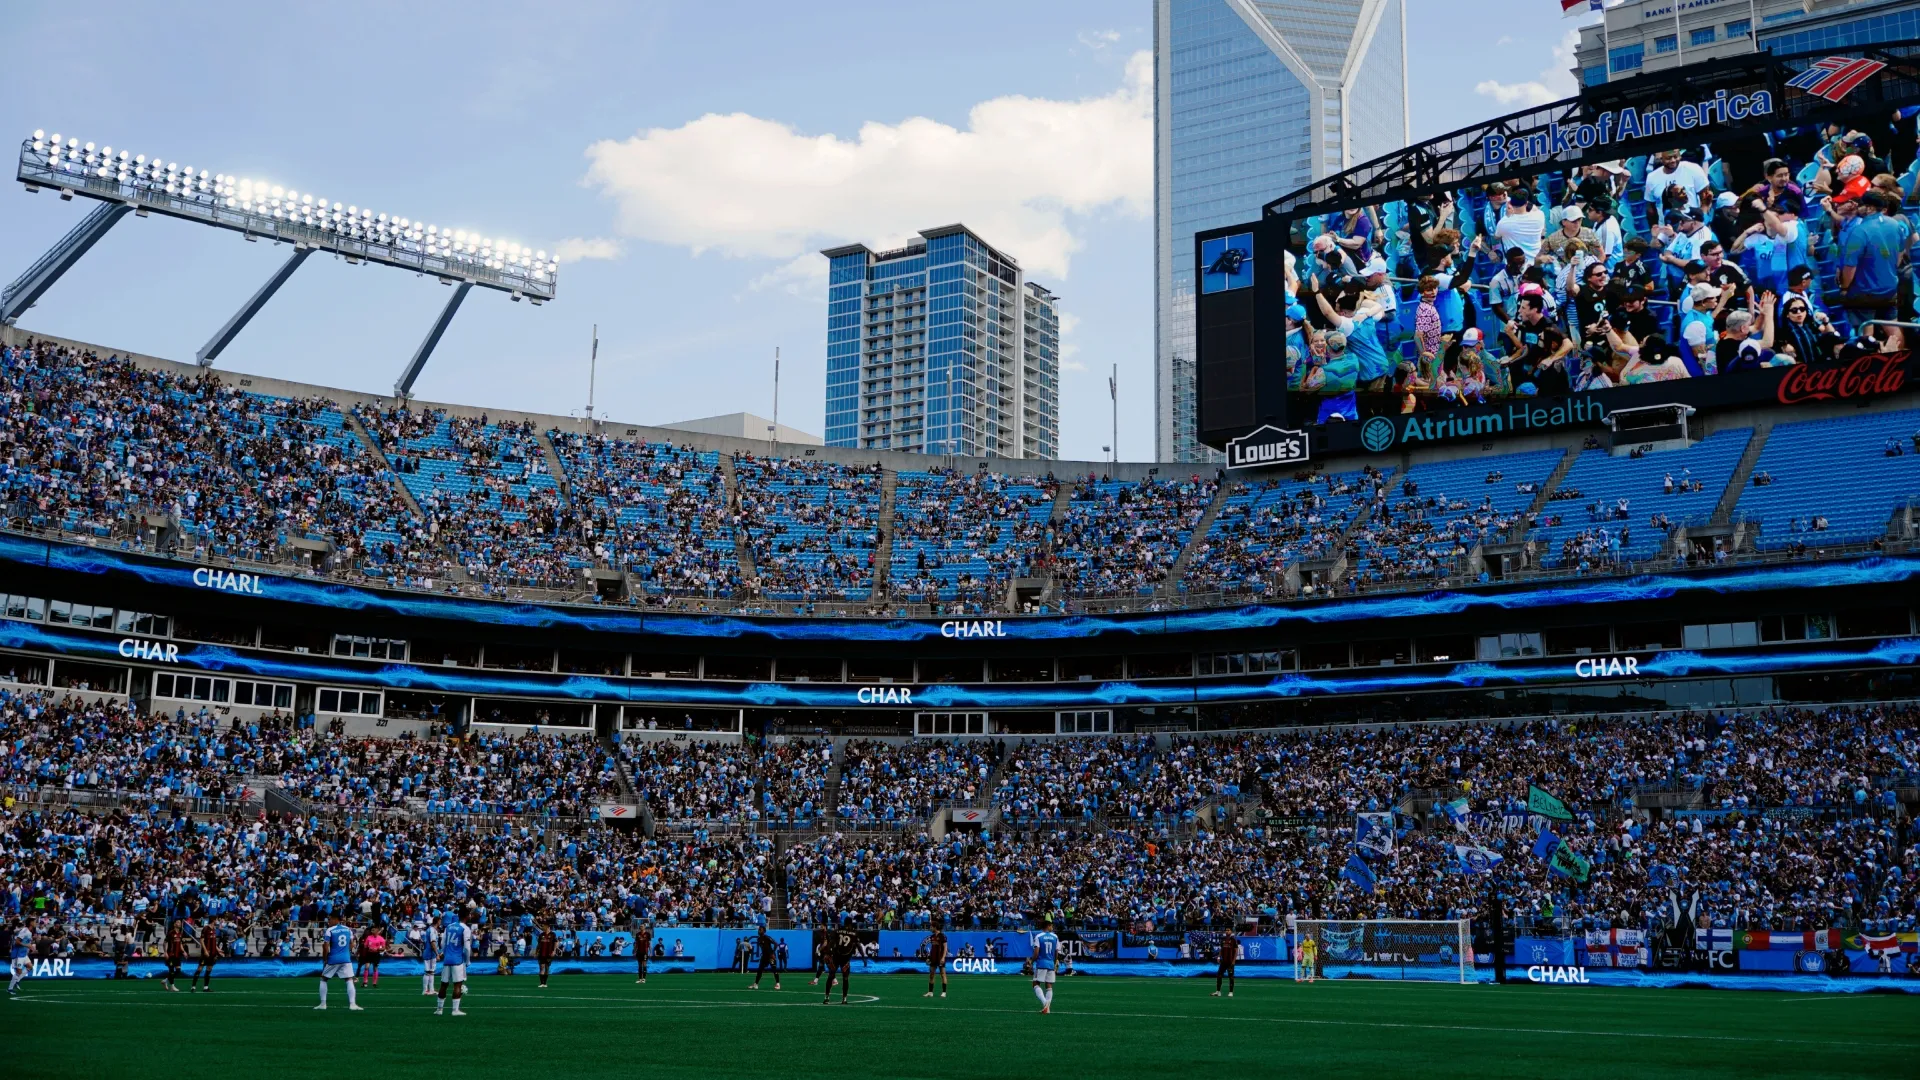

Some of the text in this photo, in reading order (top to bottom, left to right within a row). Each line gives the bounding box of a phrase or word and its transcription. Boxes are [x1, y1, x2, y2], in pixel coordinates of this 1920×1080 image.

[1645, 7, 1672, 18] BANK
[1483, 89, 1773, 166] Bank of America
[1401, 395, 1604, 442] Atrium Health
[1235, 438, 1300, 464] LOWE'S
[192, 568, 263, 595] CHARL
[941, 620, 1006, 637] CHARL
[118, 637, 178, 663] CHAR
[1575, 657, 1640, 678] CHAR
[857, 687, 912, 704] CHAR
[375, 718, 388, 727] 321
[338, 934, 347, 947] 8
[446, 931, 459, 947] 14
[838, 934, 851, 947] 19
[1044, 941, 1053, 954] 11
[1411, 935, 1440, 944] ROYAL
[1443, 934, 1476, 944] FAMY
[953, 957, 998, 972] CHARL
[1708, 950, 1734, 968] FC
[1527, 966, 1590, 983] CHARL
